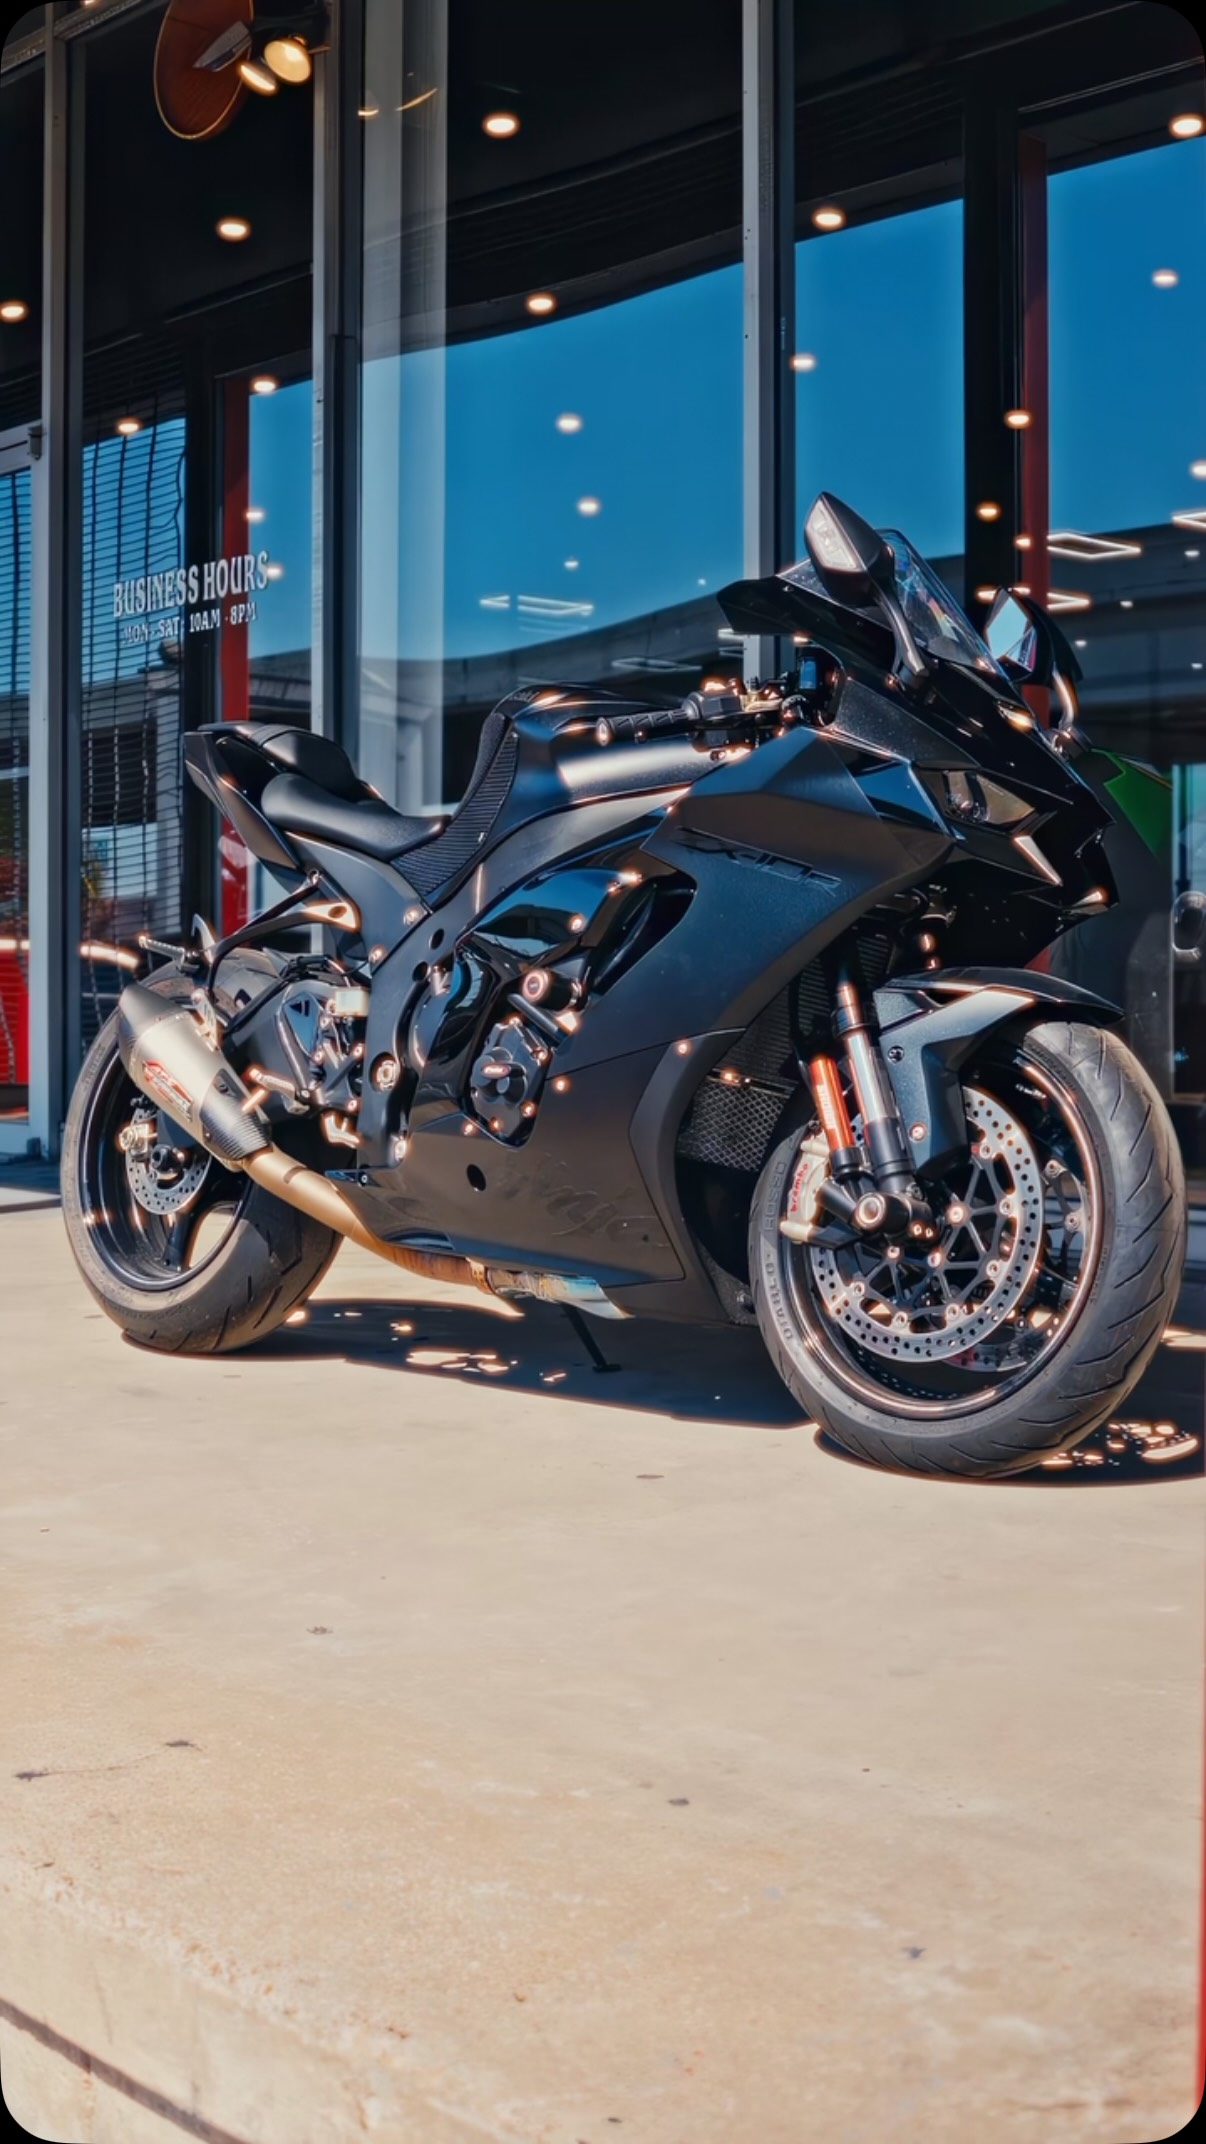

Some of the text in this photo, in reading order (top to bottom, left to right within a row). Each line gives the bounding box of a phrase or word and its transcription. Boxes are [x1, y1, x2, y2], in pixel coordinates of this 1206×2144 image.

[113, 550, 269, 618] BUSINESS HOURS
[123, 622, 149, 645] MON
[189, 608, 220, 633] 10AM
[230, 601, 257, 626] 8PM
[790, 1163, 809, 1214] brembo
